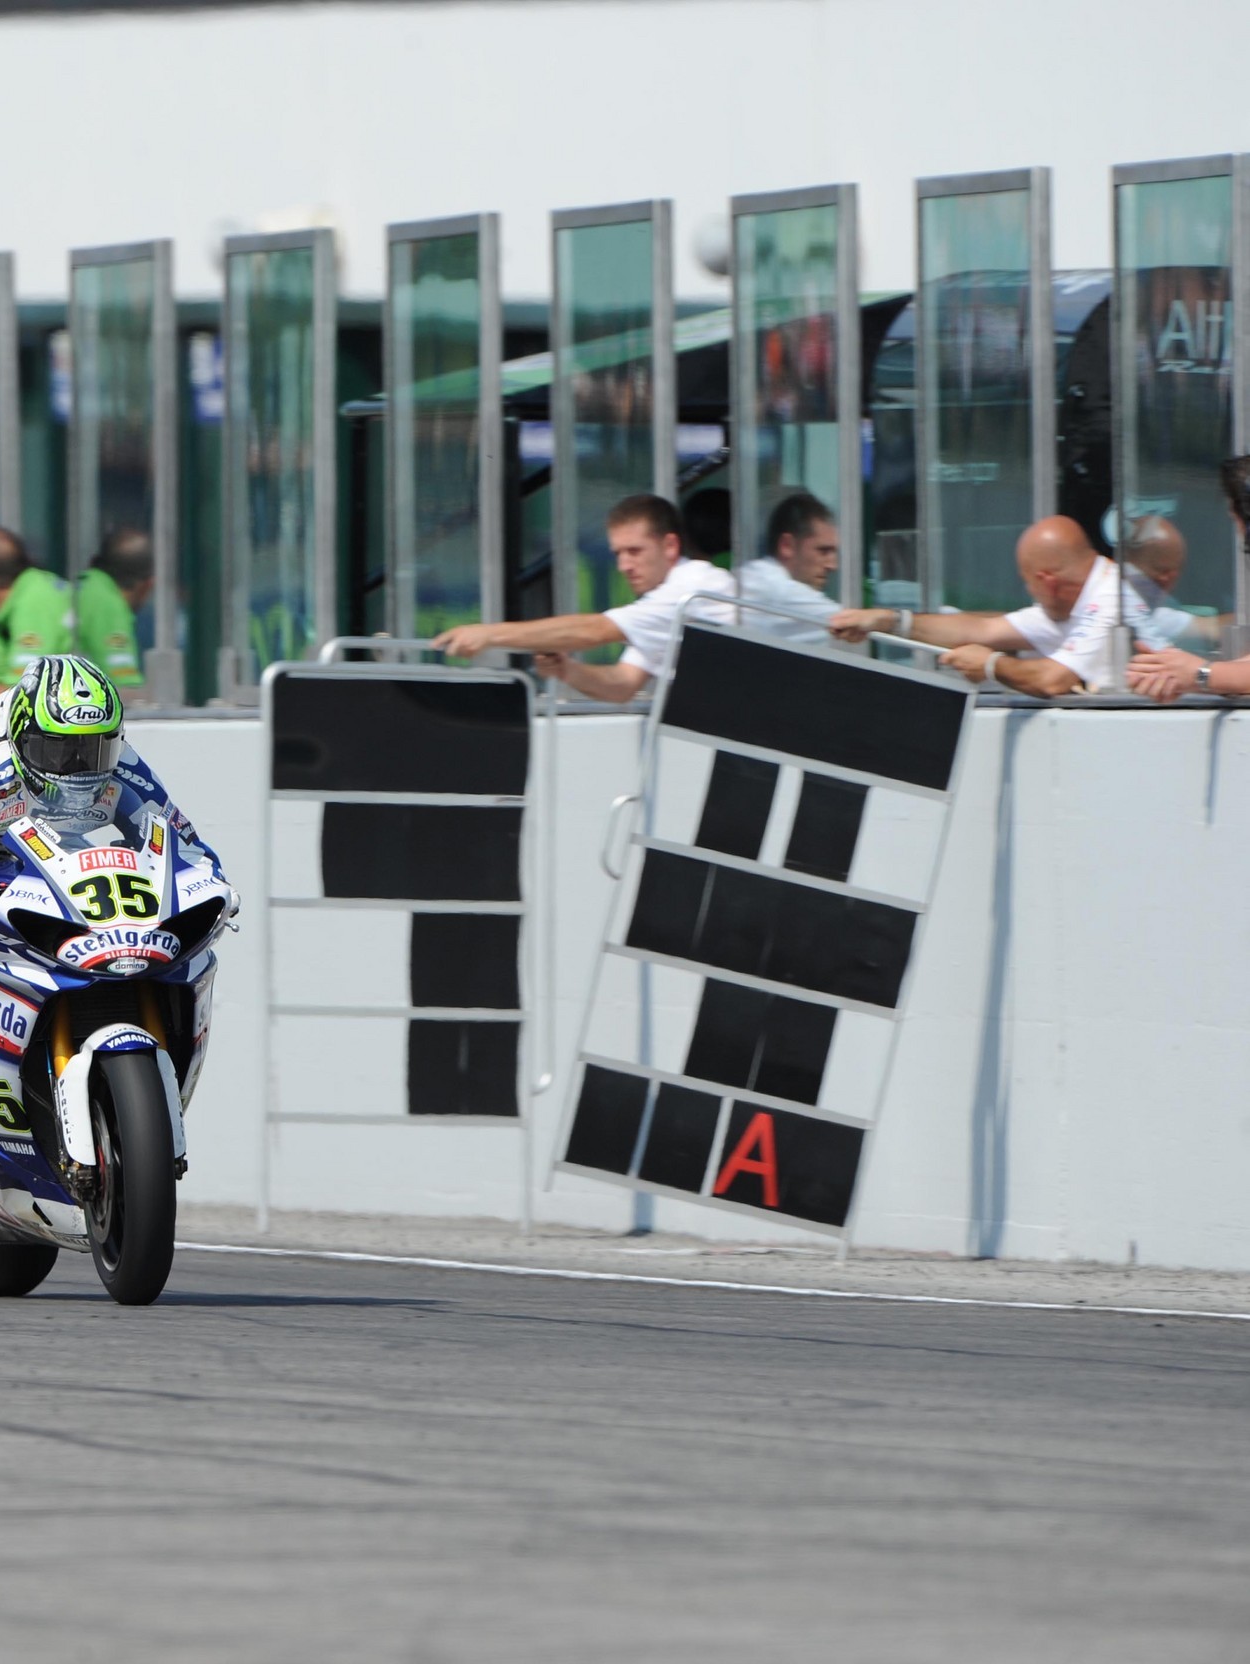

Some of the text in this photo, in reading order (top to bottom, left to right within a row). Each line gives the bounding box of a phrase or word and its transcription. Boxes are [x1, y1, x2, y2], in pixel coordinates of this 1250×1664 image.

[66, 707, 103, 720] Arai
[82, 851, 135, 870] FIMER
[68, 872, 161, 922] 35
[65, 929, 180, 963] sterilgarda
[105, 949, 151, 960] alimenti
[106, 1034, 154, 1049] YAMAHA
[0, 1140, 36, 1156] YAMAHA
[711, 1112, 779, 1207] A
